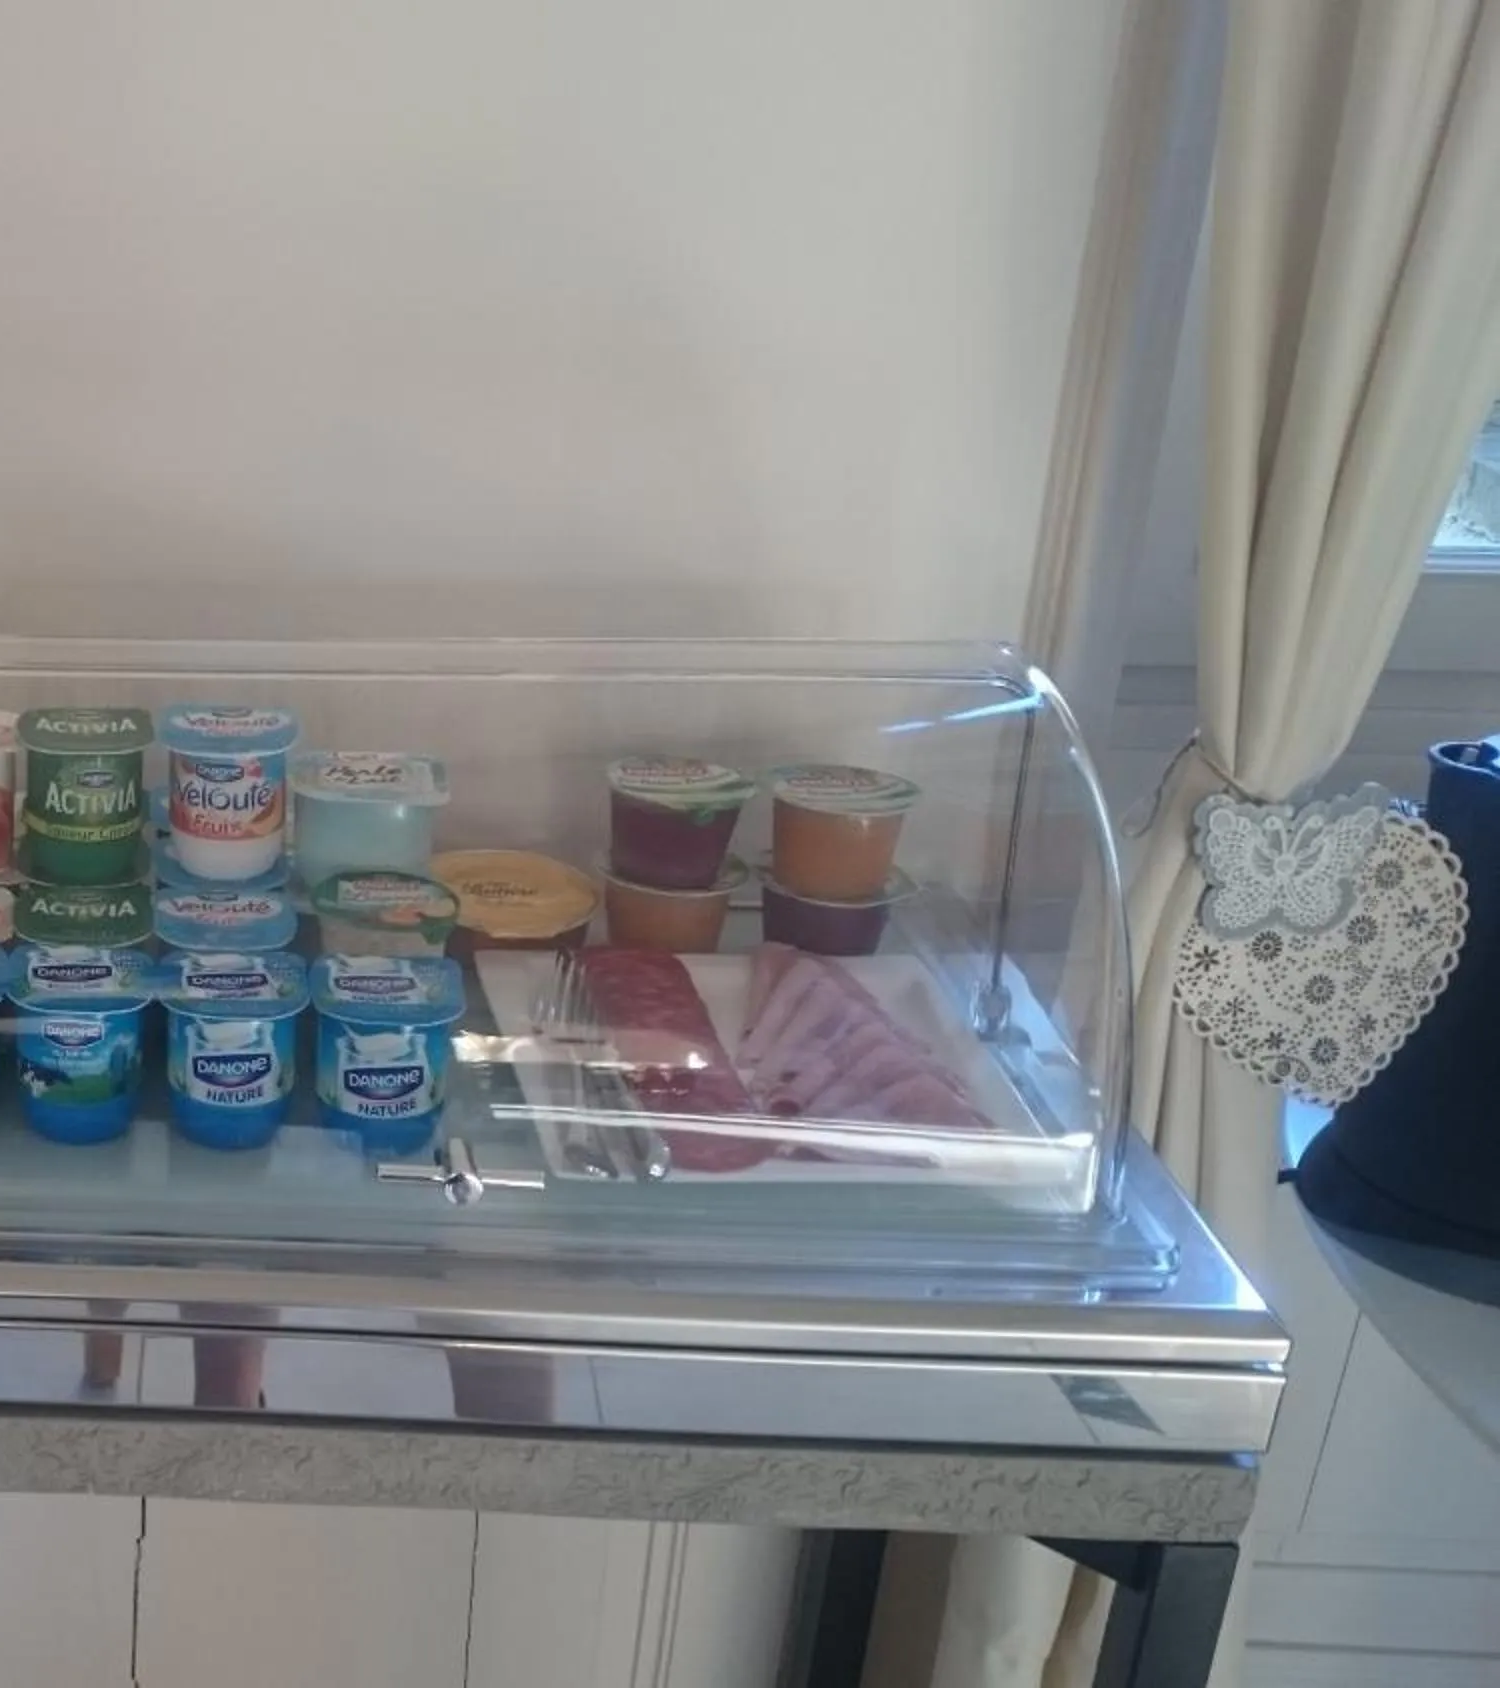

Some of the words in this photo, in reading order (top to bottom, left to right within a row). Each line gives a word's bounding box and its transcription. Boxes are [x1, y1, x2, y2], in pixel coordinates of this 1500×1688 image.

[35, 717, 138, 737] ACTIVIA
[45, 780, 137, 815] ACTIVIA
[31, 898, 137, 918] ACTIVIA
[37, 966, 108, 979] DANONE
[198, 1057, 268, 1075] DANONE
[349, 1071, 421, 1088] DANONE
[207, 1087, 264, 1105] NATURE
[357, 1099, 417, 1116] NATURE
